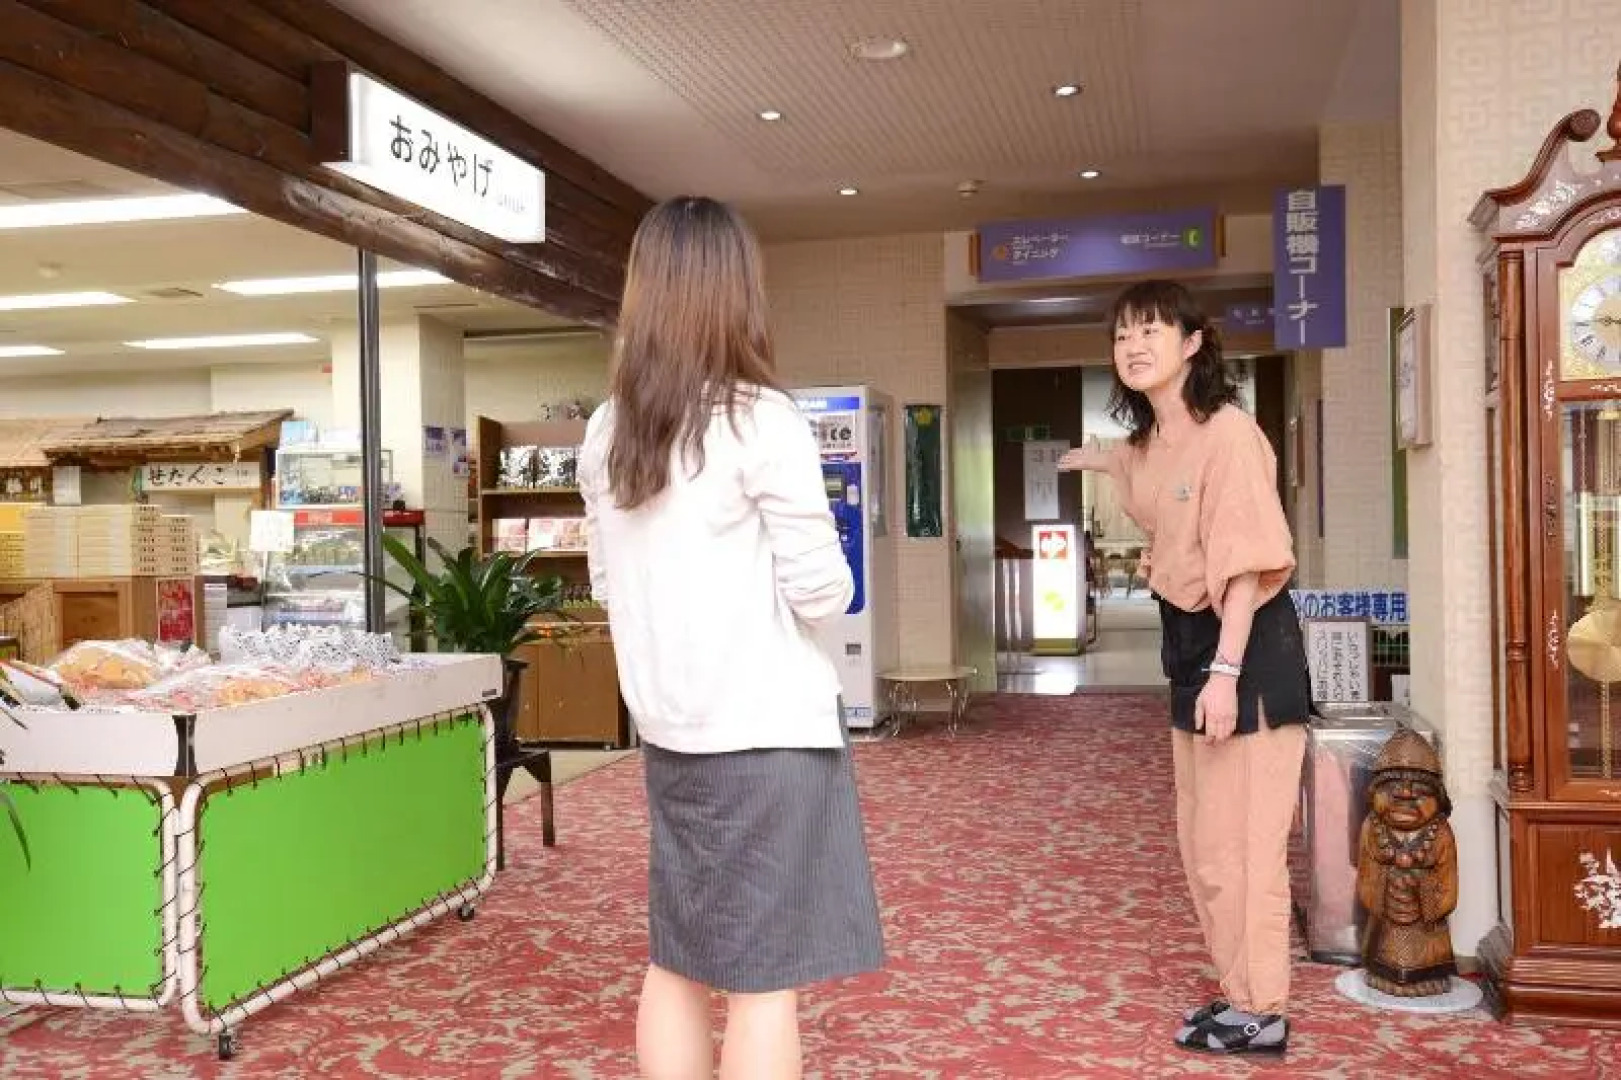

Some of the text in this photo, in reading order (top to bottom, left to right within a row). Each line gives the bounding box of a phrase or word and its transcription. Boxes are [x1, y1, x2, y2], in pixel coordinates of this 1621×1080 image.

[389, 114, 494, 198] おみやげ
[1286, 189, 1320, 345] 自販機コーナー
[1292, 591, 1406, 622] のお客様専用
